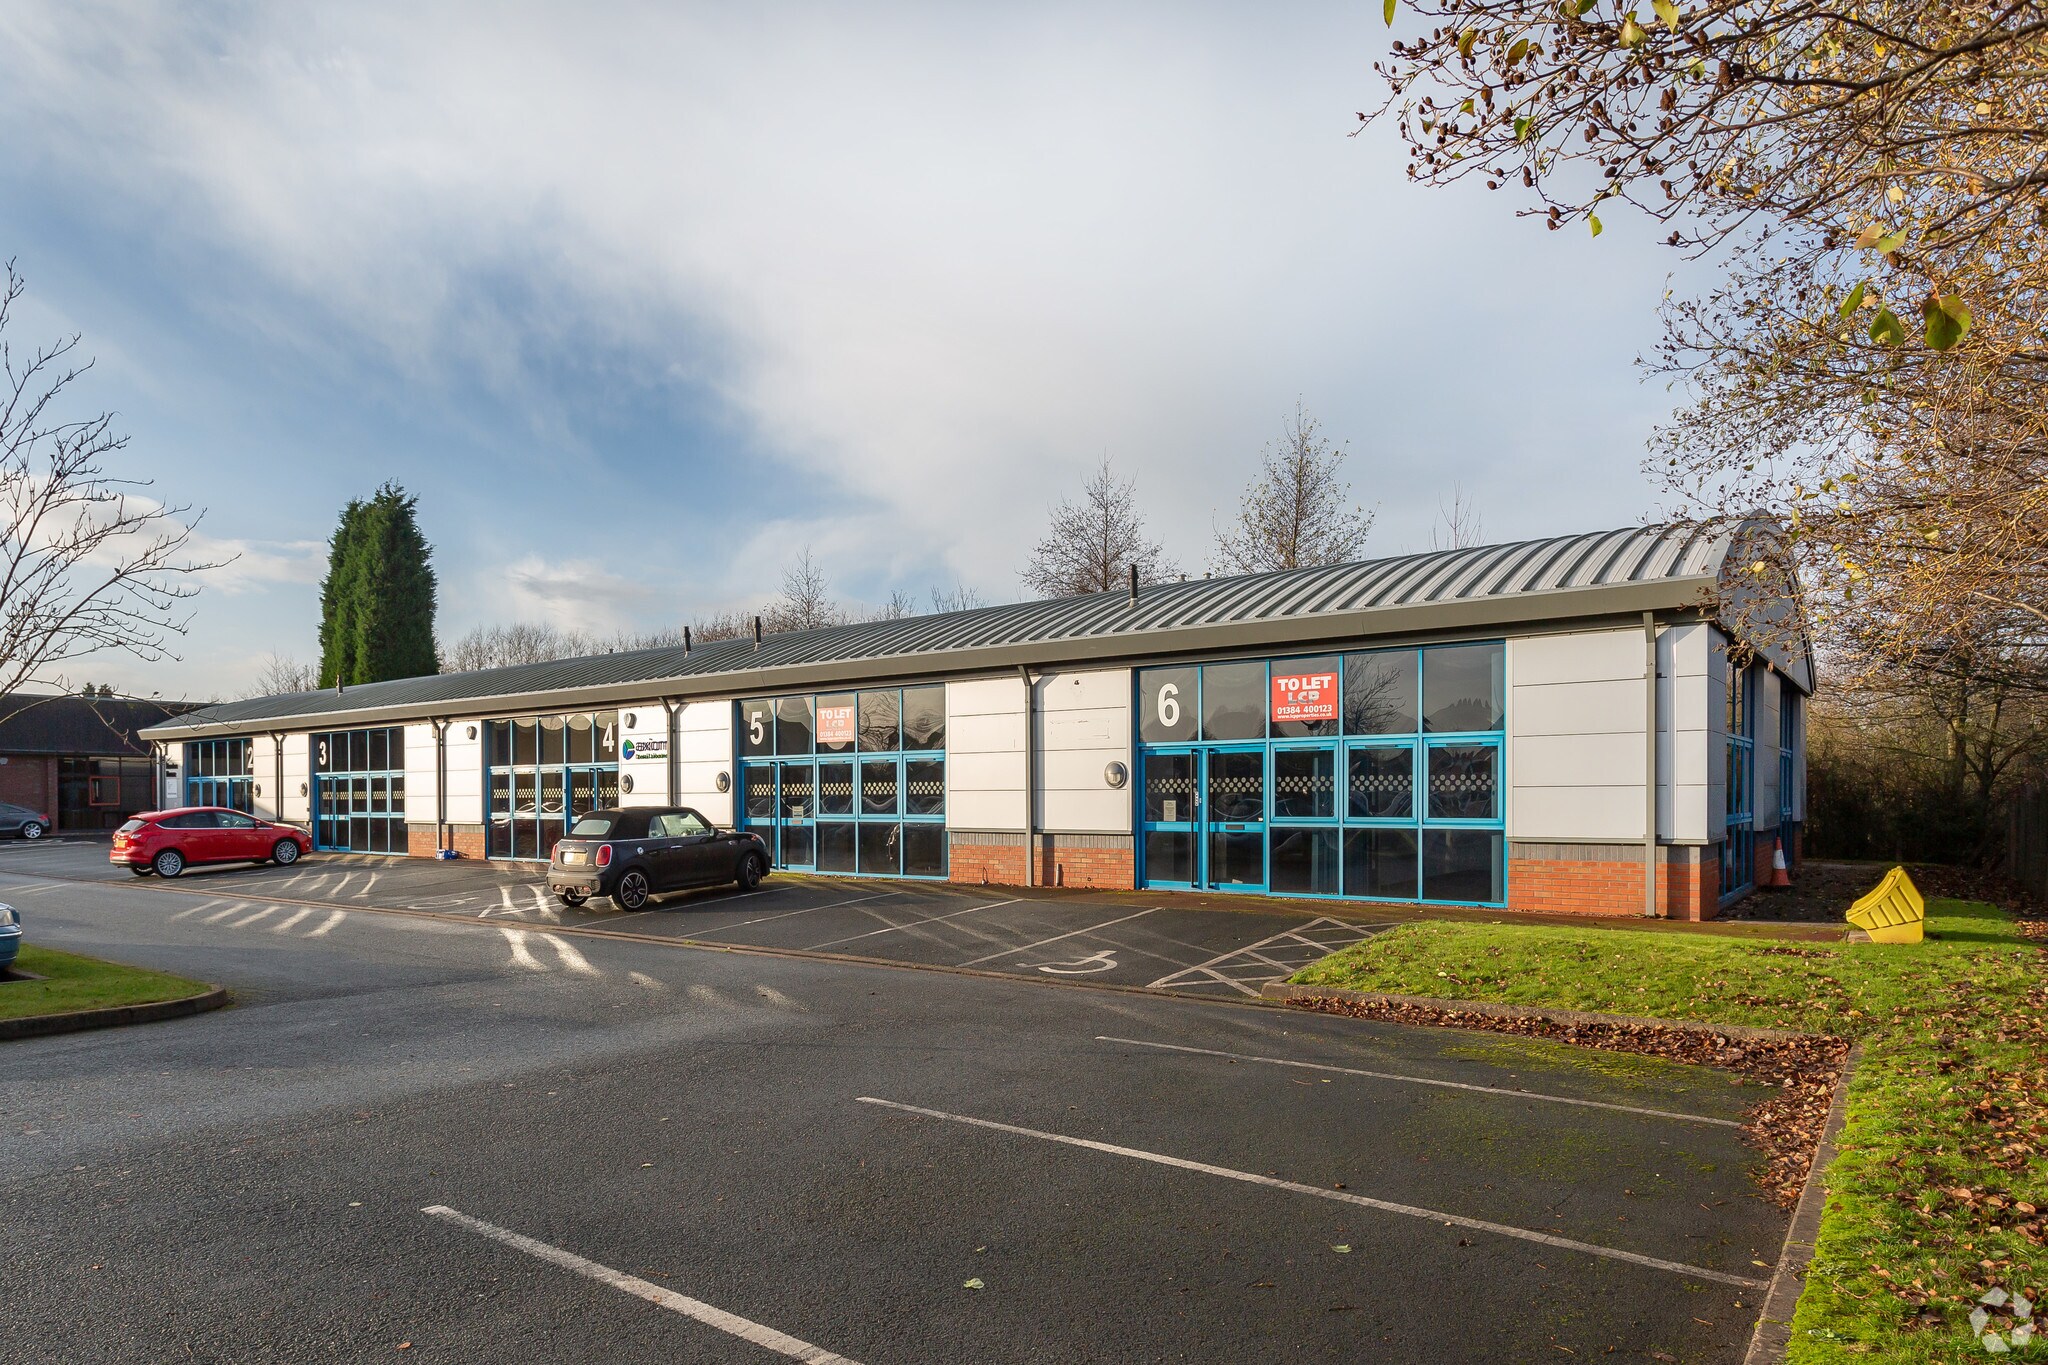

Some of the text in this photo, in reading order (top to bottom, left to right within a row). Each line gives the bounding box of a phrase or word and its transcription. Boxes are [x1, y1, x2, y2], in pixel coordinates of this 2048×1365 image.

[1277, 675, 1332, 692] TO LET
[1157, 683, 1180, 727] 6
[1287, 691, 1320, 705] LCP
[820, 708, 851, 720] TO LET
[1277, 704, 1332, 715] 01384 400123
[602, 721, 615, 753] 4
[749, 711, 764, 746] 5
[318, 740, 328, 766] 3
